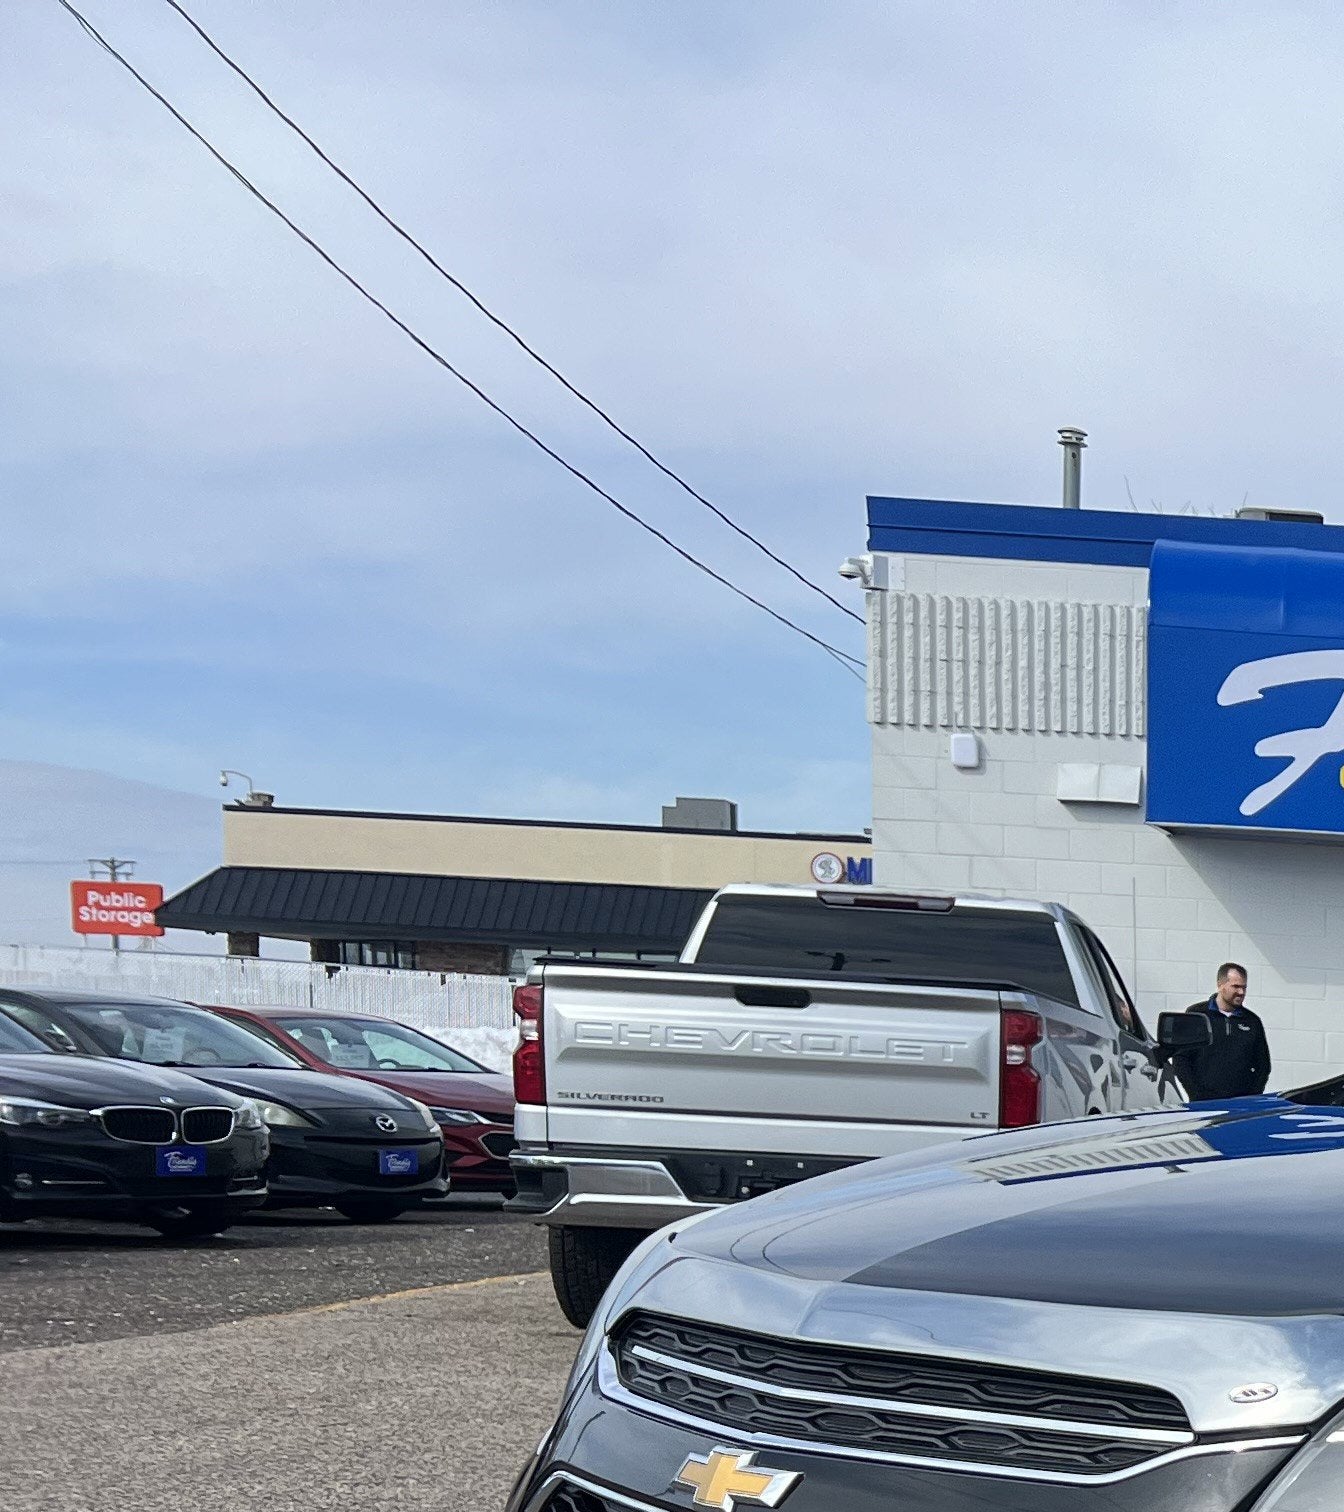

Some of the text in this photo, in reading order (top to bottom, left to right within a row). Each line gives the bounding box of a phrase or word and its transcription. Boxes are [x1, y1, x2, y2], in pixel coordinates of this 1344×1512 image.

[87, 890, 147, 908] Public
[79, 906, 155, 928] Storage
[574, 1021, 968, 1062] CHEVROLET
[557, 1091, 664, 1103] SILVERADO
